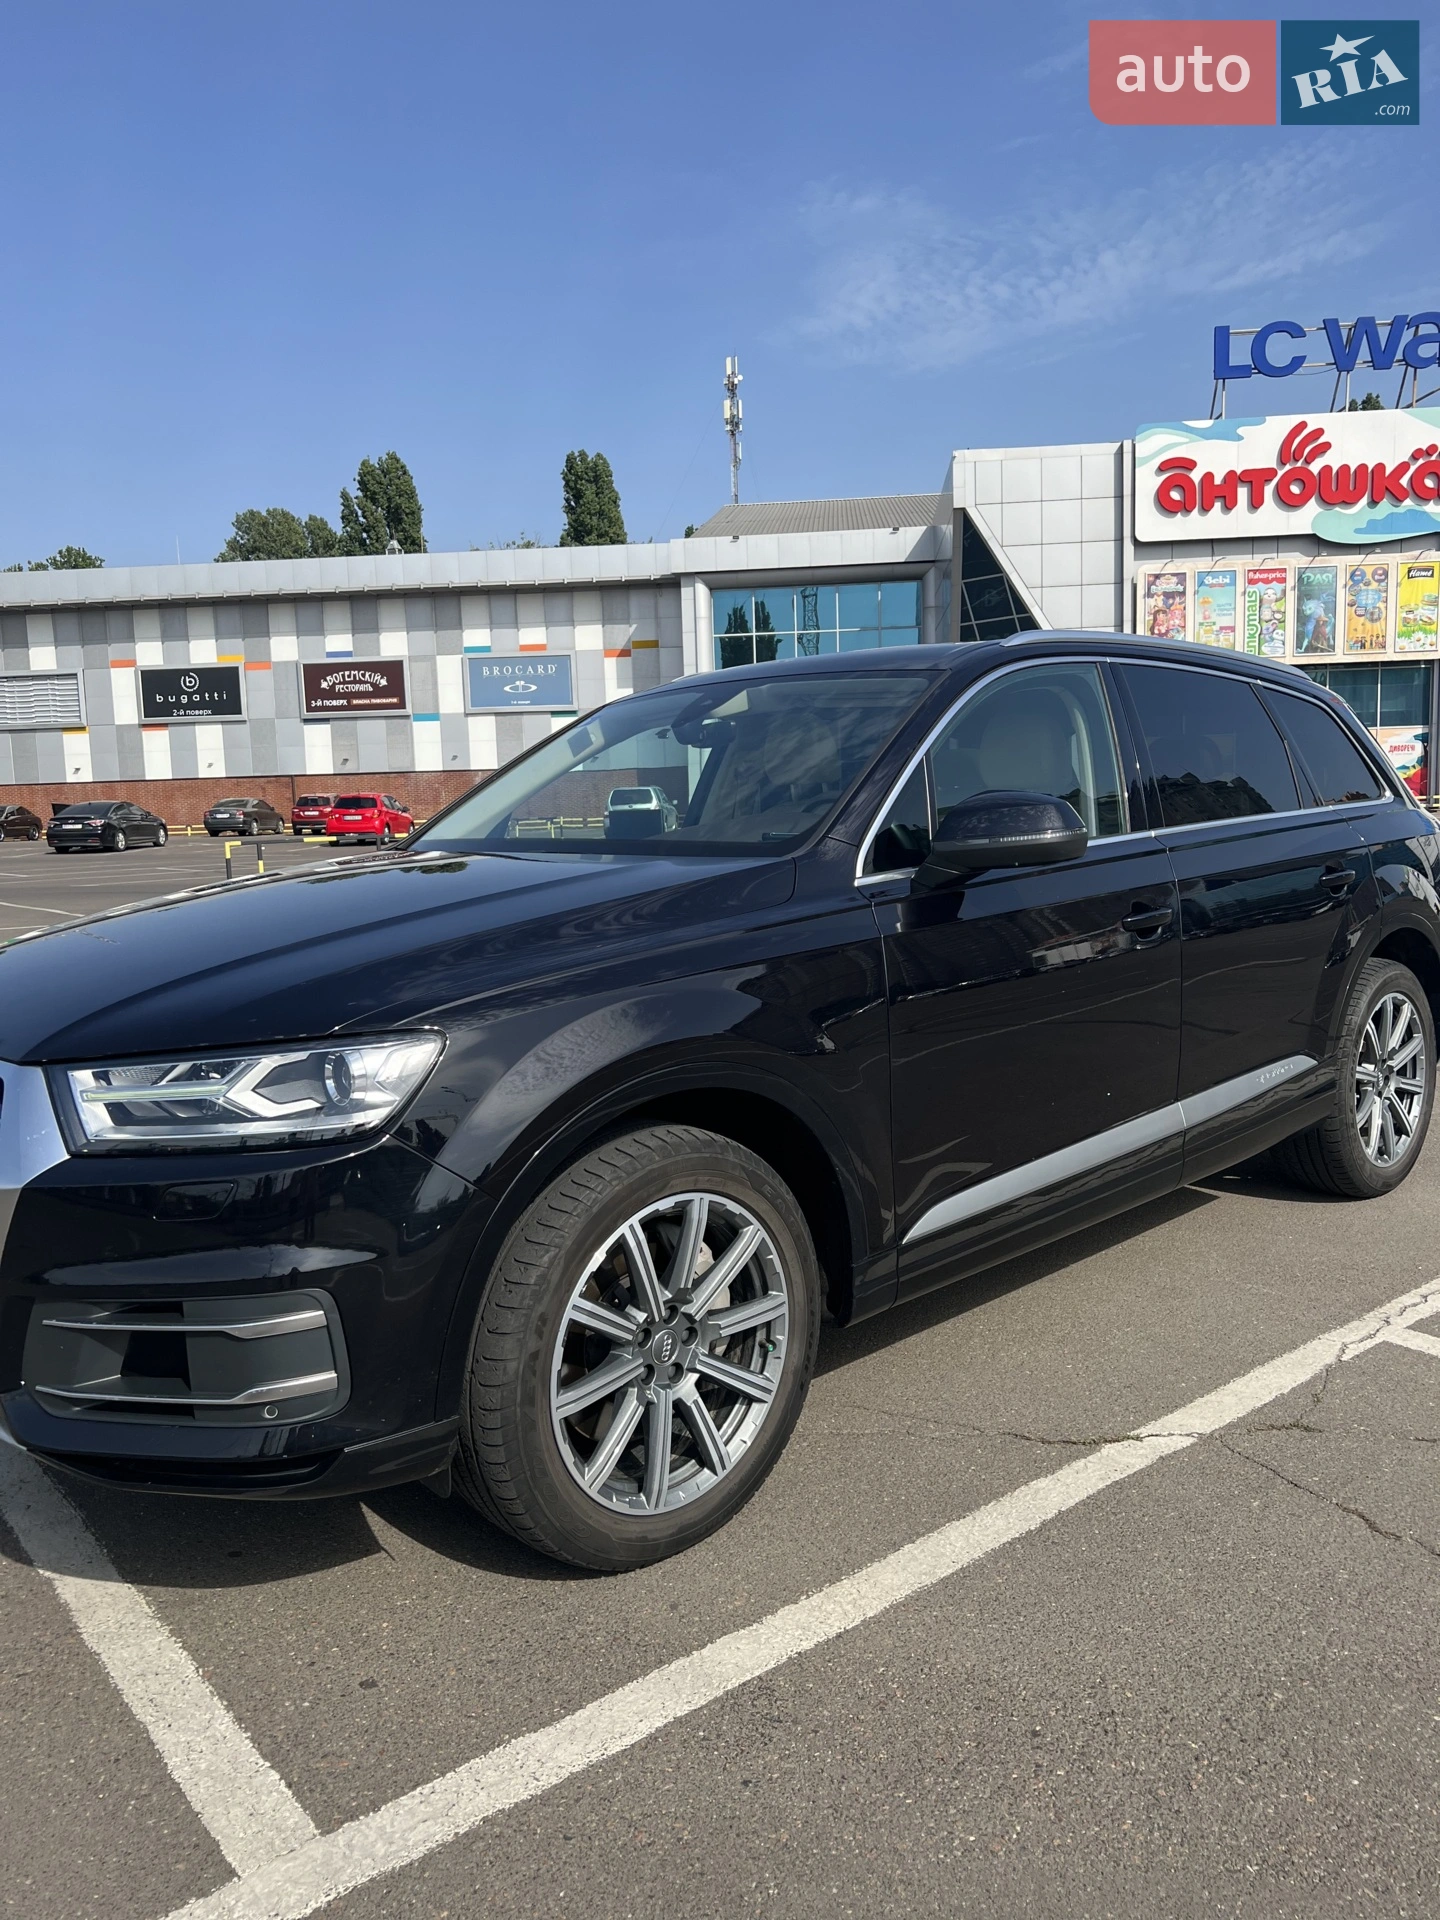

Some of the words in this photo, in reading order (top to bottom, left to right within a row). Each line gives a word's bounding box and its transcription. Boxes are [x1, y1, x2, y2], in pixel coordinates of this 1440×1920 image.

[1213, 320, 1308, 380] LC
[1204, 575, 1231, 585] Bebi
[1301, 572, 1333, 586] РАЯ
[482, 664, 556, 676] BROCARD
[326, 670, 382, 686] БОГЕМСКІЙ
[156, 691, 227, 704] bugatti
[311, 699, 323, 707] 3-Й
[323, 699, 348, 707] ПОВЕРХ
[172, 708, 185, 716] 2-й
[186, 708, 212, 717] поверх
